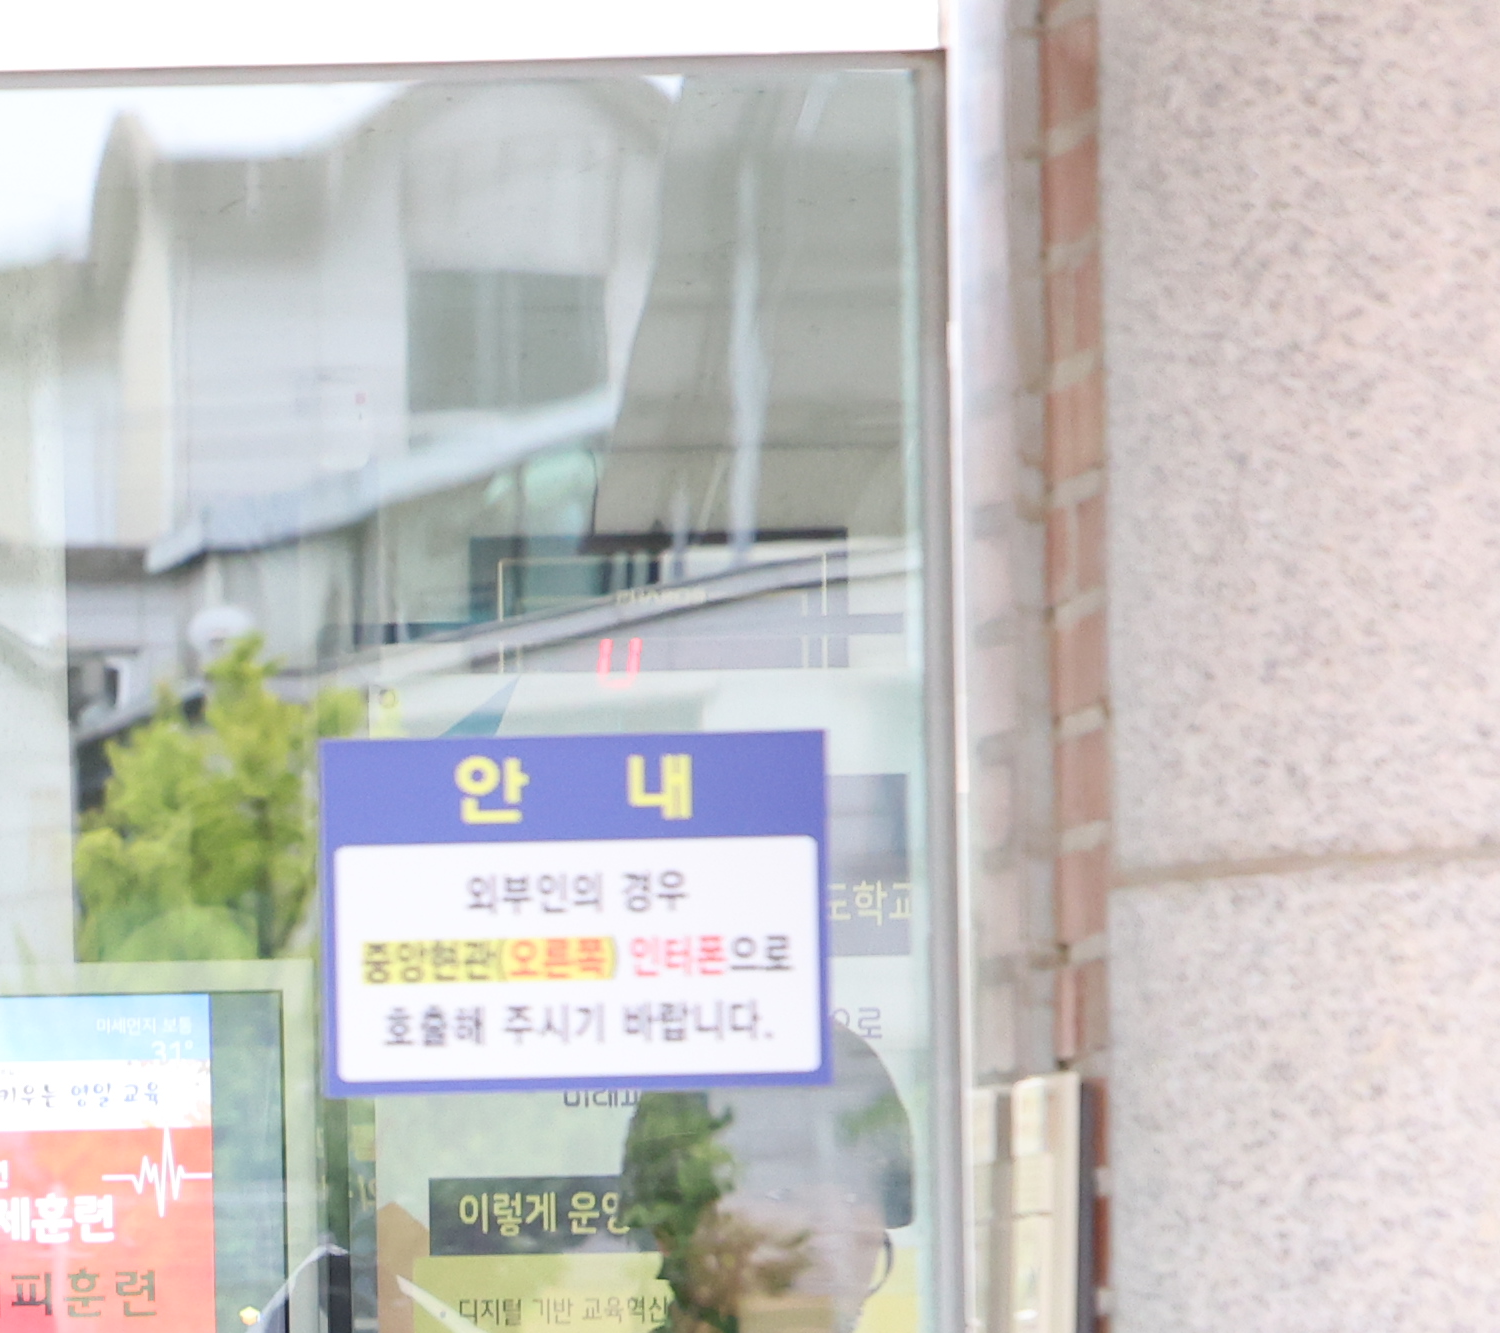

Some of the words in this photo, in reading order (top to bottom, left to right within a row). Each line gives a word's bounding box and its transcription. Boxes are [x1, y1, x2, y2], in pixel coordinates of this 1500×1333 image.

[454, 755, 530, 825] 안
[626, 753, 694, 821] 내
[466, 872, 604, 915] 외부인의
[622, 869, 689, 914] 경우
[362, 936, 618, 985] 중앙현관(오른쪽)
[629, 934, 796, 980] 인터폰으로
[383, 1005, 486, 1050] 호출해
[503, 1001, 606, 1045] 주시기
[622, 999, 776, 1043] 바랍니다.
[123, 1081, 160, 1107] 교육
[458, 1192, 557, 1238] 이렇게
[458, 1298, 522, 1327] 디지털
[532, 1297, 574, 1326] 기반
